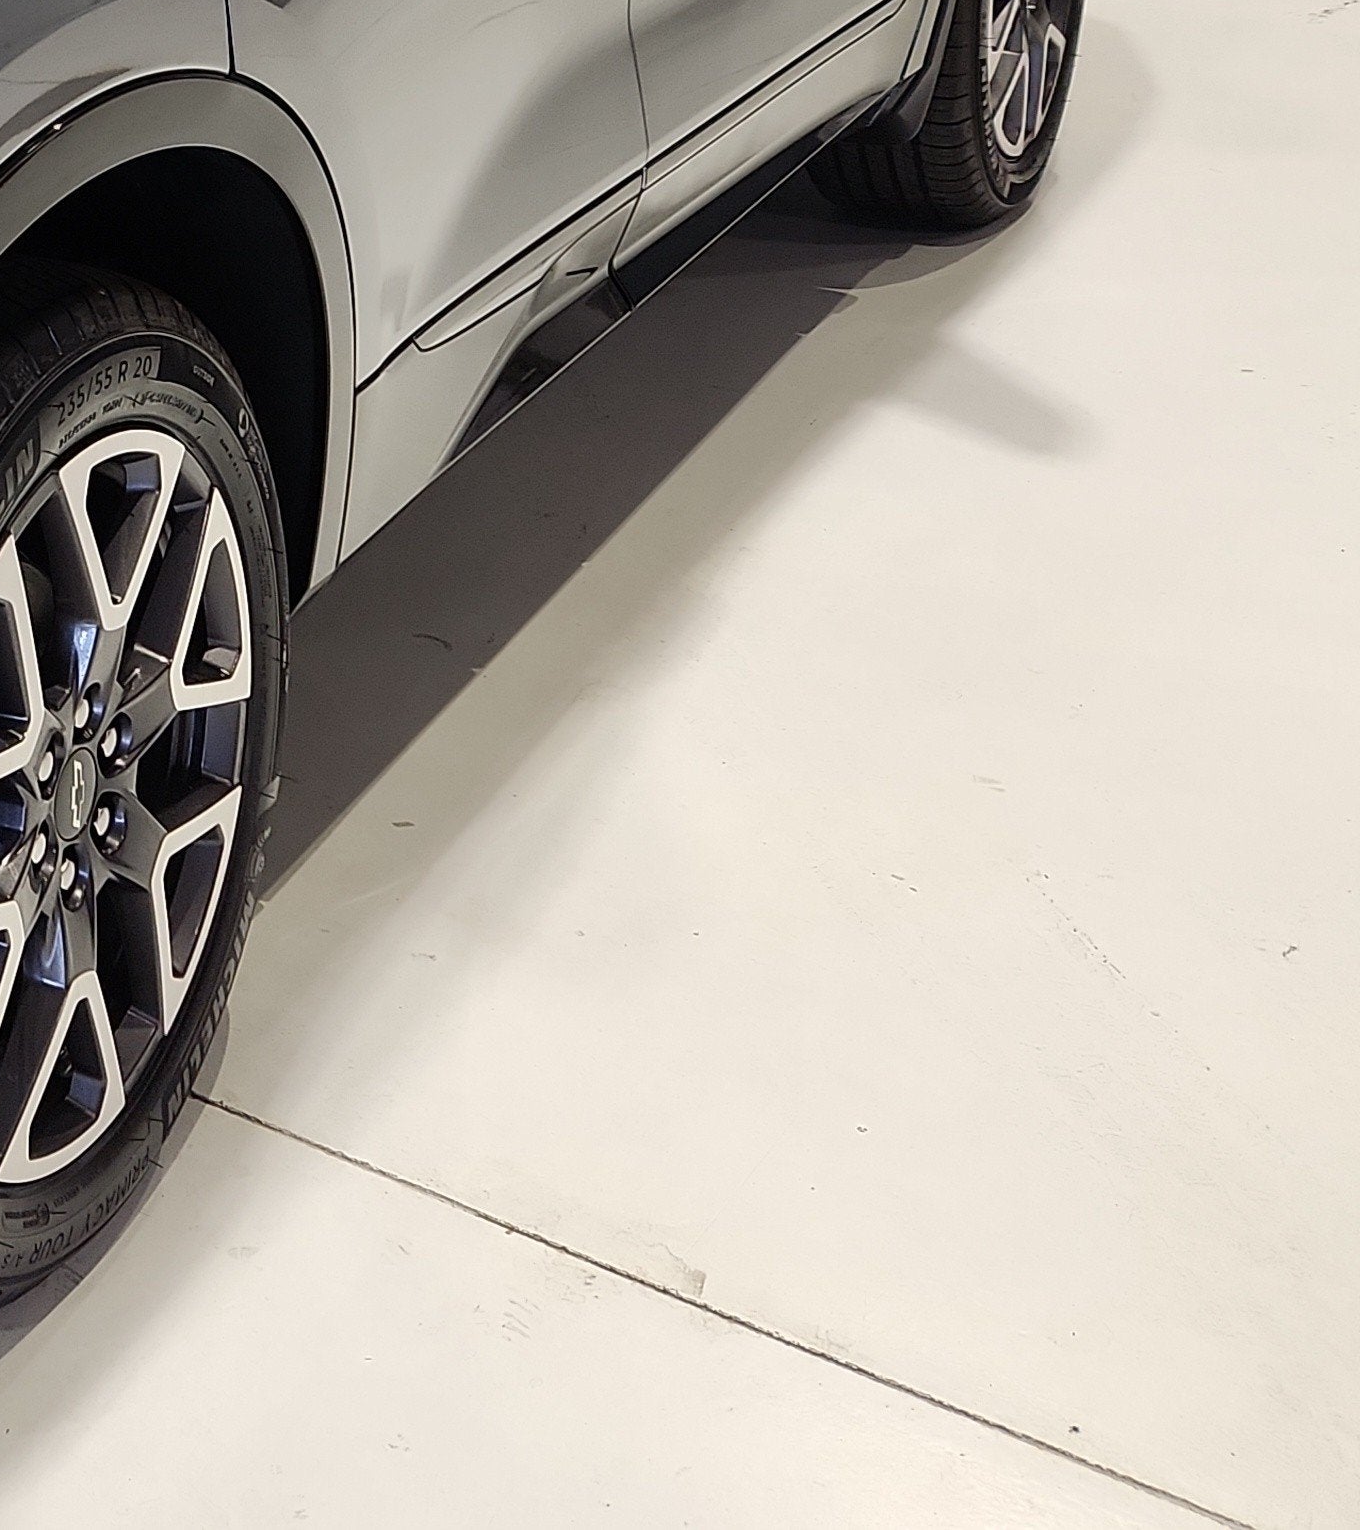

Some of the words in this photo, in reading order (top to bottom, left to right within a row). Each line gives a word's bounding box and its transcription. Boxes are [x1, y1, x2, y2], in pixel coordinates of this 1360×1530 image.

[57, 364, 113, 428] 235/55
[117, 360, 129, 385] R
[133, 354, 153, 379] 20
[82, 1146, 150, 1240] PRIMACY
[30, 1225, 75, 1261] TOUR
